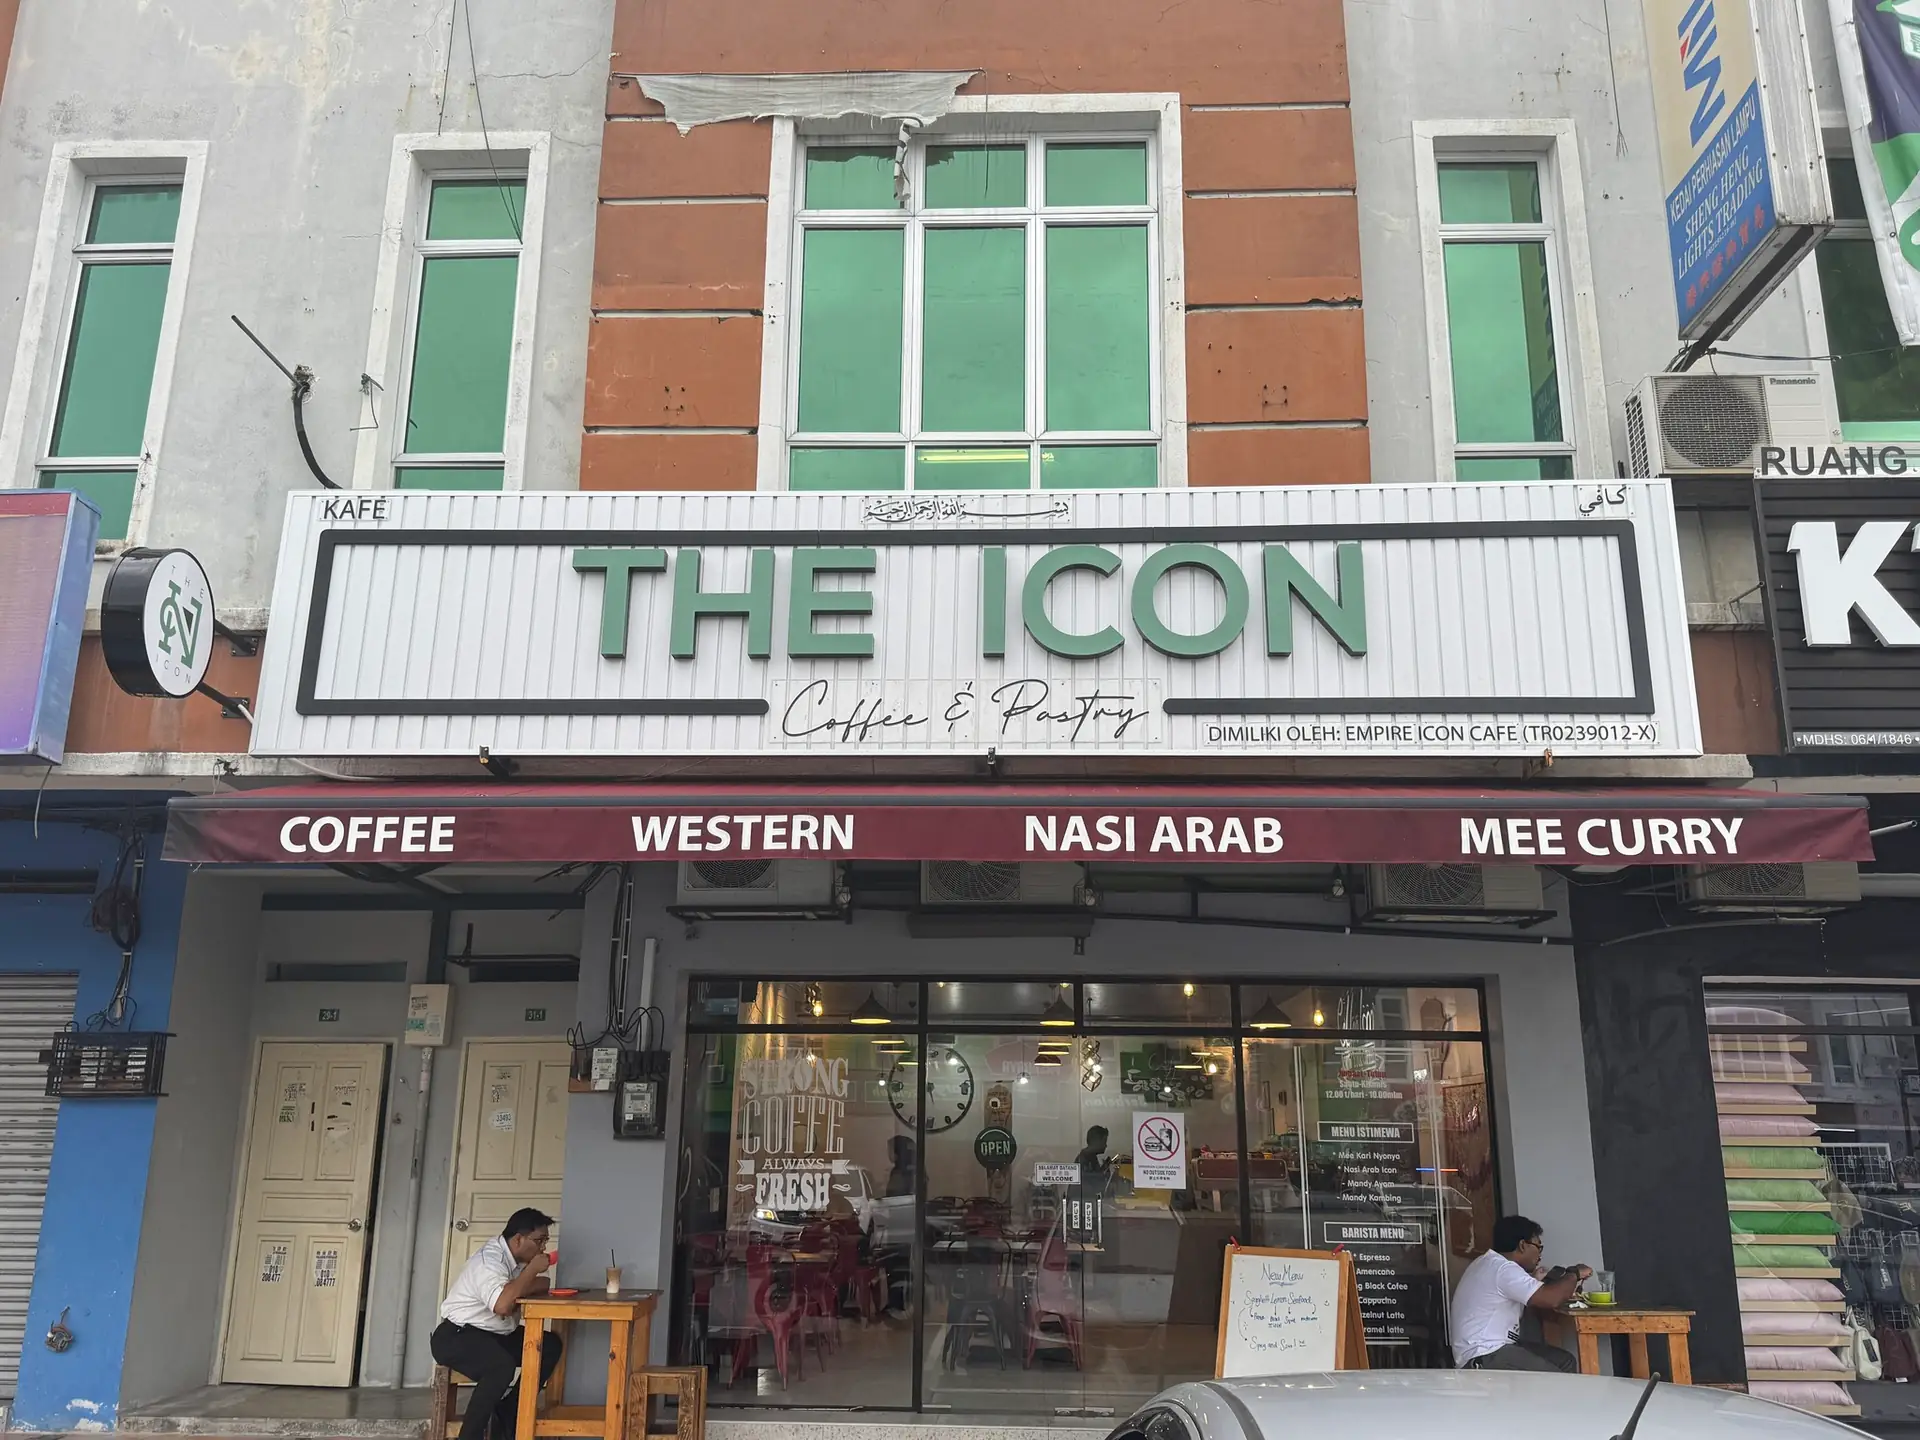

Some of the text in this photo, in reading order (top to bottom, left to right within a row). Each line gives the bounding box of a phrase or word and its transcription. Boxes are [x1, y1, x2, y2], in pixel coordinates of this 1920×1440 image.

[1670, 190, 1692, 226] KEDAI
[1692, 128, 1732, 199] PERHIASAN
[1731, 93, 1757, 150] LAMPU
[1684, 191, 1719, 244] SHENG
[1721, 145, 1749, 202] HENG
[1677, 220, 1715, 281] LIGHTS
[1716, 157, 1764, 235] TRADING
[1769, 377, 1817, 385] Panasonic
[1760, 446, 1908, 476] RUANG
[323, 499, 388, 521] KAFE
[572, 543, 1368, 661] THE ICON
[155, 653, 192, 684] ICON
[782, 678, 1150, 743] Coffee & Pastry
[1208, 725, 1656, 742] DIMILIKI OLEH: EMPIRE ICON CAFE (TR0239012-X)
[1803, 734, 1847, 746] MDHS:
[279, 816, 456, 854] COFFEE
[632, 815, 854, 853] WESTERN
[1025, 815, 1284, 854] NASI ARAB
[1460, 817, 1744, 855] MEE CURRY
[740, 1056, 850, 1100] STRONG
[742, 1095, 845, 1155] COFFE
[1331, 1126, 1401, 1138] MENU ISTIMEWA
[980, 1140, 1011, 1156] OPEN
[1356, 1151, 1371, 1160] Kari
[1373, 1152, 1401, 1161] Nyonya
[761, 1158, 825, 1170] ALWAYS
[1381, 1166, 1398, 1174] Icon
[755, 1172, 831, 1211] FRESH
[1347, 1180, 1372, 1189] Mandy
[1342, 1194, 1402, 1204] Mandy Kambing
[1341, 1227, 1405, 1239] BARISTA MENU
[1359, 1253, 1391, 1263] Espresso
[1261, 1263, 1304, 1281] New Menu
[1365, 1282, 1386, 1290] Black
[1386, 1311, 1405, 1319] Latte
[1386, 1325, 1405, 1334] latte
